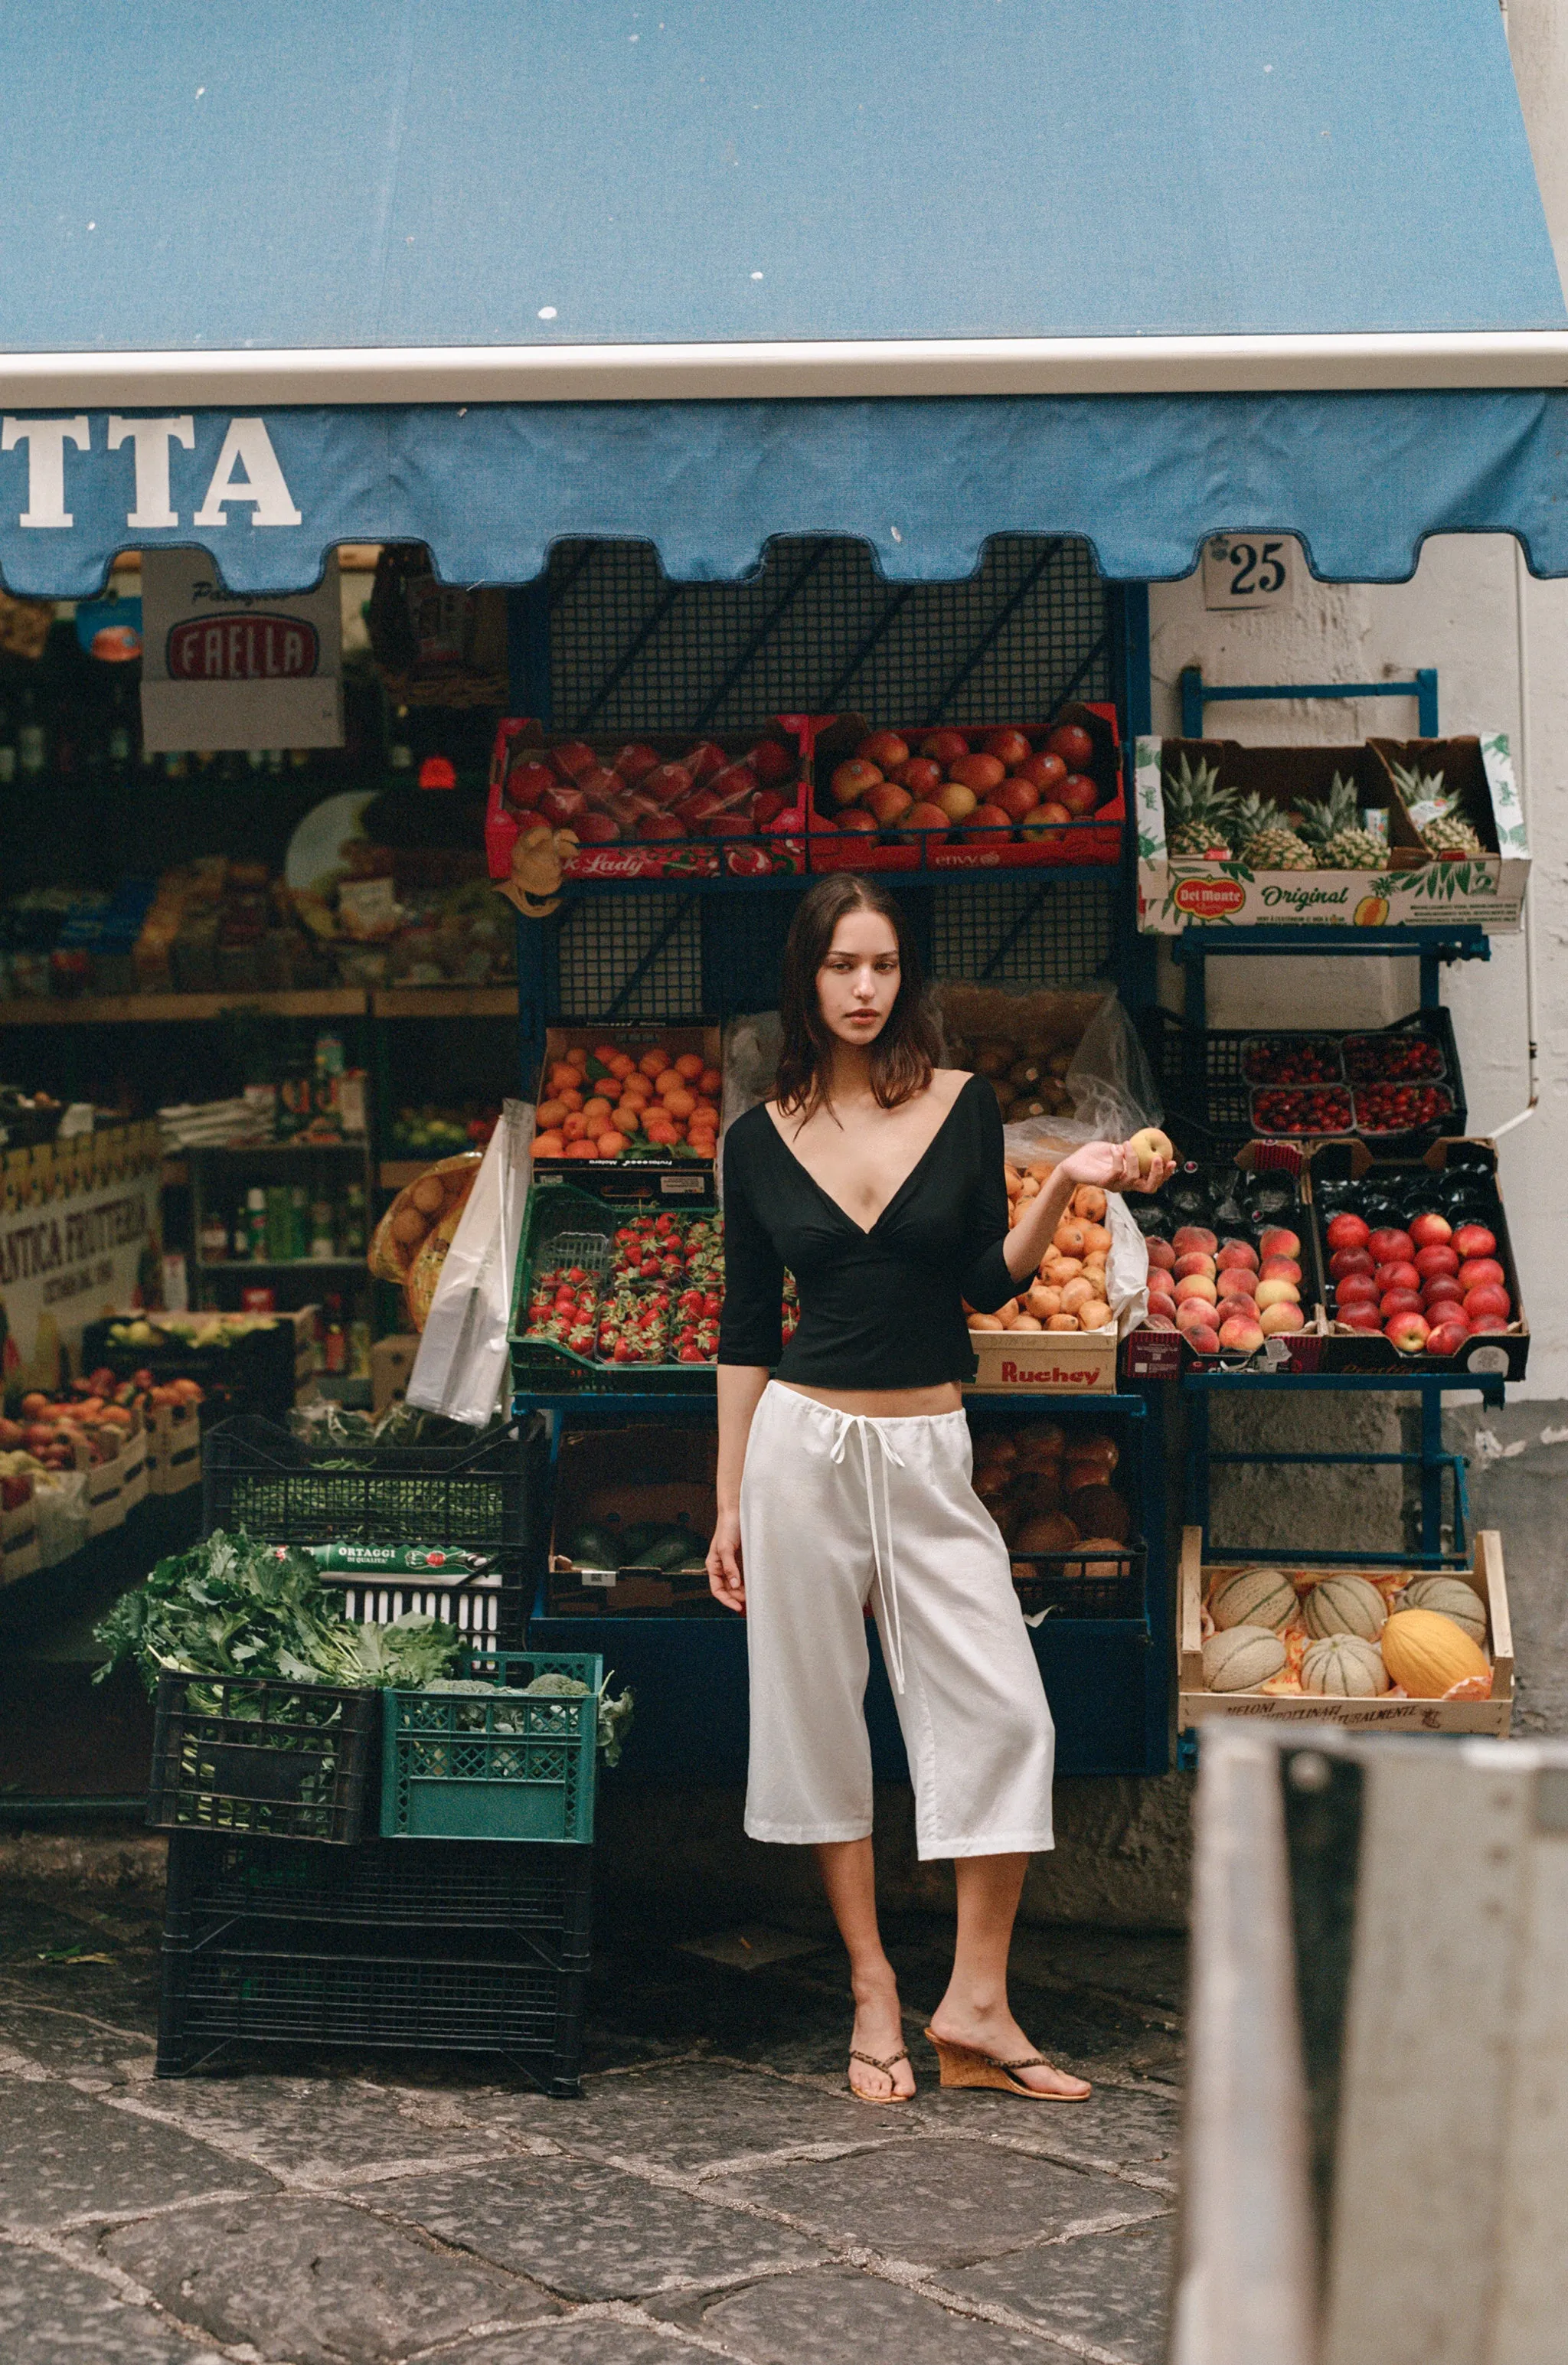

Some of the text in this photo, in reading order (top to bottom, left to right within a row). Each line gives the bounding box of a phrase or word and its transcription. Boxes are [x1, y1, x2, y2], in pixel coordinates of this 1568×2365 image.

[2, 415, 302, 528] TTA
[1230, 543, 1286, 594] 25
[182, 624, 304, 678] FAELLA
[582, 852, 645, 877] Lady
[936, 854, 978, 867] envy
[1180, 890, 1241, 902] Del Monte
[1261, 886, 1349, 912] Original
[0, 1218, 64, 1286] NTICA
[1001, 1361, 1101, 1386] Ruchey
[338, 1547, 396, 1559] ORTAGGI
